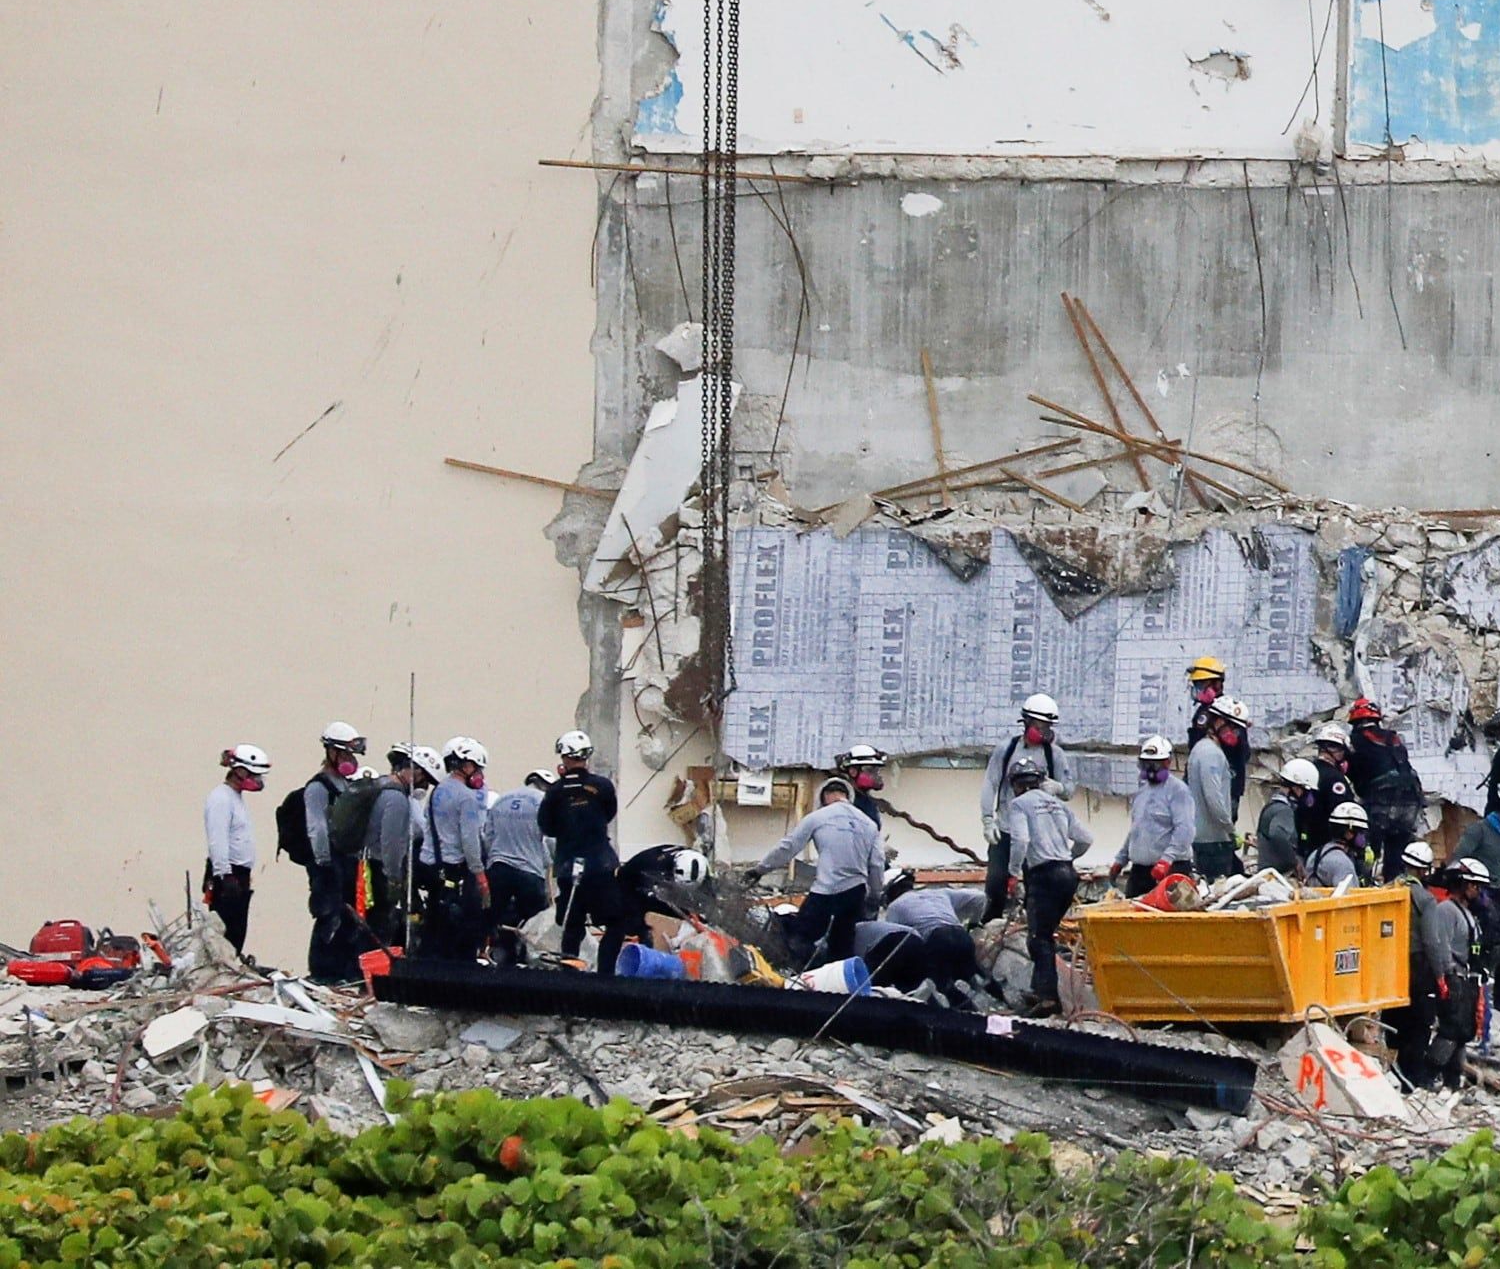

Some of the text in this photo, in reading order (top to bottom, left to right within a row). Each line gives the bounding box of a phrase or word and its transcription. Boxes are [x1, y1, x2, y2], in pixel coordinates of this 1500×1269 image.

[751, 543, 778, 668] PROFLEX
[1010, 579, 1036, 701] PROFLEX
[1268, 546, 1293, 670] PROFLEX
[879, 606, 904, 731] PROFLEX
[1139, 672, 1161, 735] FLEX
